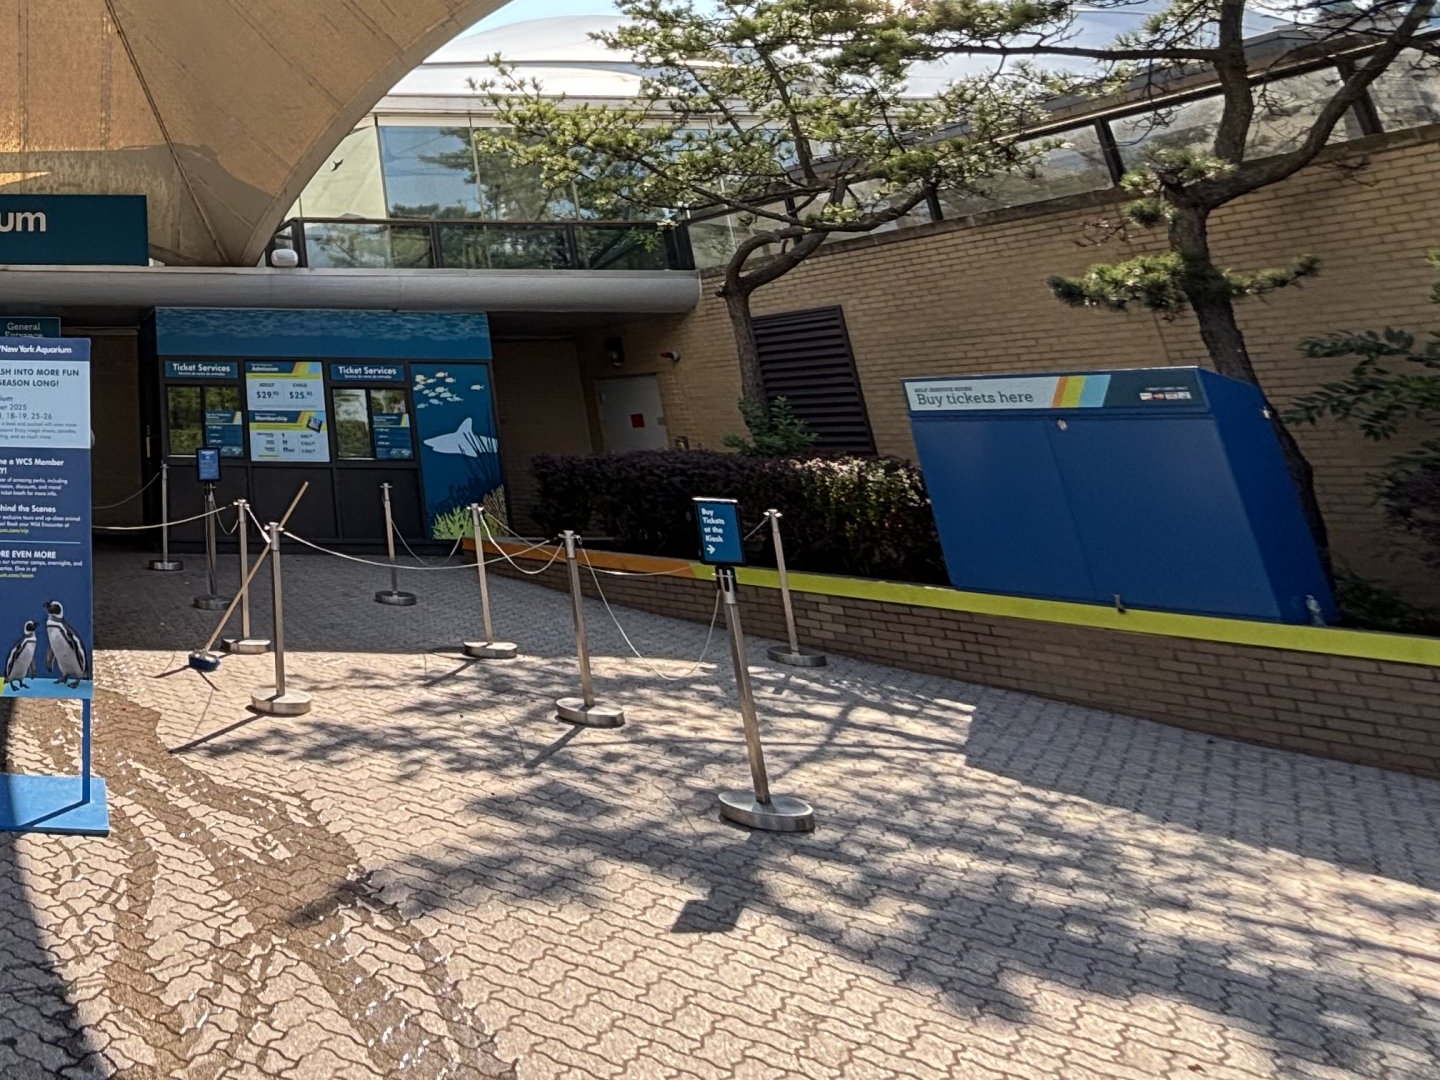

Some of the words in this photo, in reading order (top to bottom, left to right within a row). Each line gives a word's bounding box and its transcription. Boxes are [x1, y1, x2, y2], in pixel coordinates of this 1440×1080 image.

[6, 322, 40, 331] General
[0, 345, 18, 353] New
[19, 345, 35, 353] York
[36, 345, 72, 355] Aquarium
[173, 363, 195, 371] Ticket
[198, 364, 230, 372] Services
[338, 366, 361, 374] Ticket
[364, 366, 397, 375] Services
[33, 380, 59, 388] LONG!
[916, 393, 942, 408] Buy
[946, 392, 996, 405] tickets
[998, 391, 1033, 403] here
[34, 458, 64, 466] Member
[32, 505, 56, 513] Scenes
[701, 508, 714, 516] Buy
[702, 517, 725, 525] Tickets
[12, 550, 32, 558] EVEN
